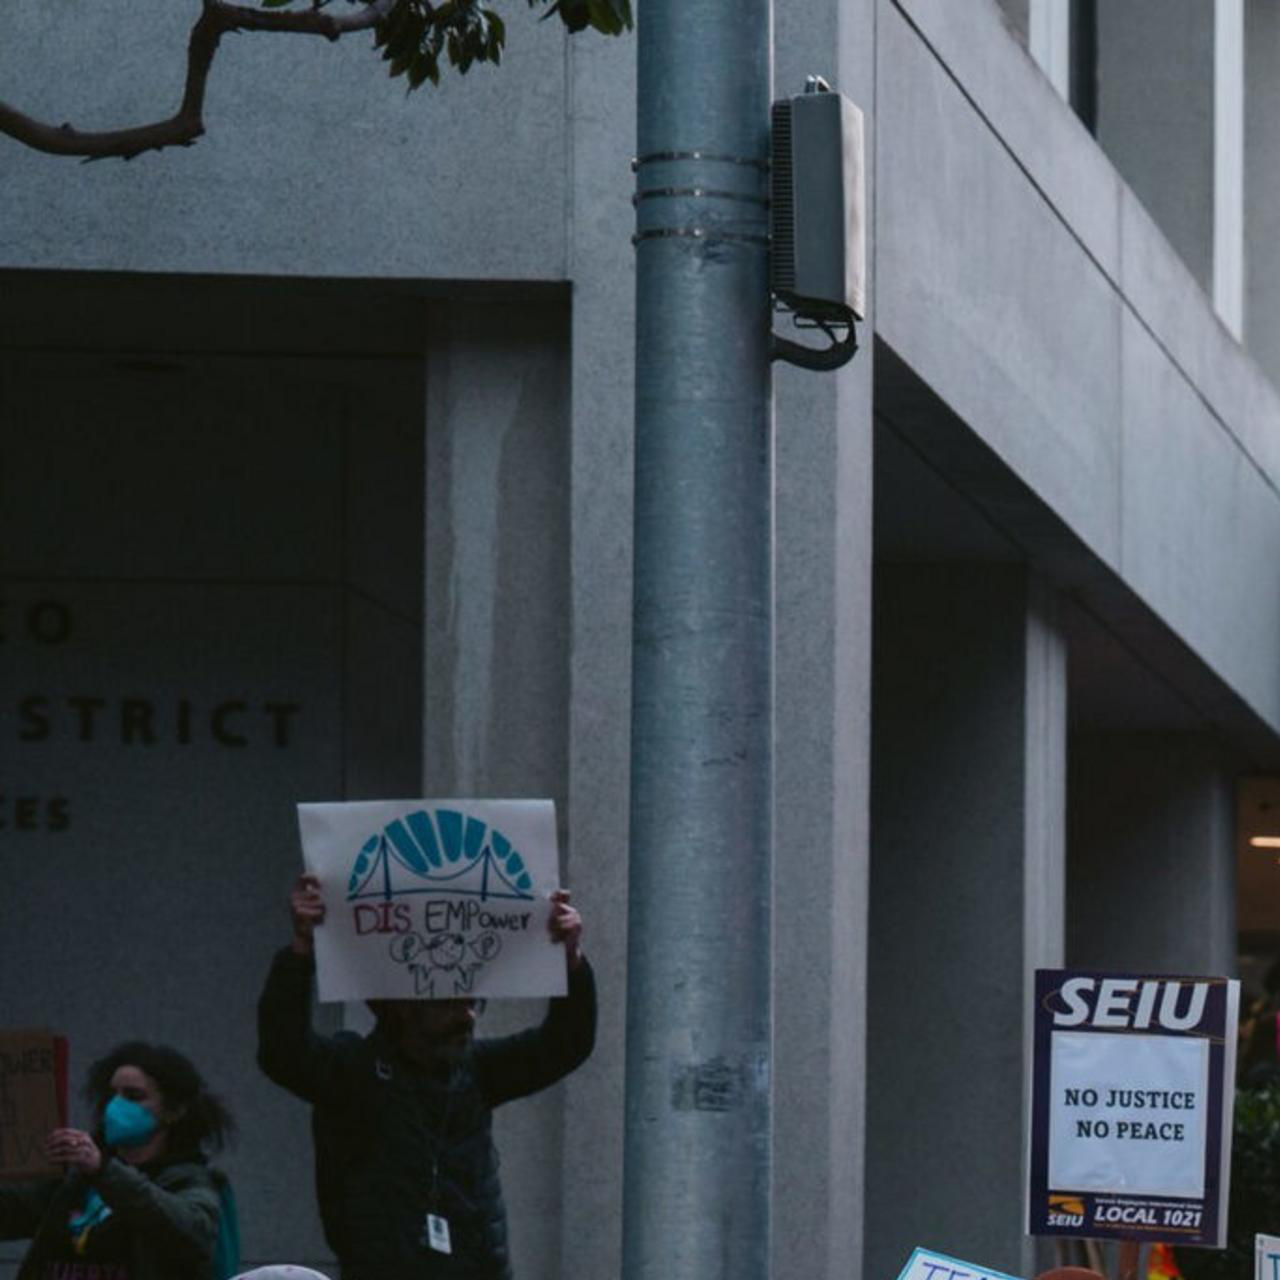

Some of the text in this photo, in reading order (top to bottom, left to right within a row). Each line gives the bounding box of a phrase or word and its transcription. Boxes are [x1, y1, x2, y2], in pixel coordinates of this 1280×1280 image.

[354, 903, 412, 935] DIS
[1054, 976, 1208, 1031] SEIU
[1064, 1088, 1196, 1110] NO JUSTICE
[1077, 1121, 1185, 1142] NO PEACE
[1047, 1211, 1084, 1227] SEIU
[1094, 1206, 1202, 1227] LOCAL 1021
